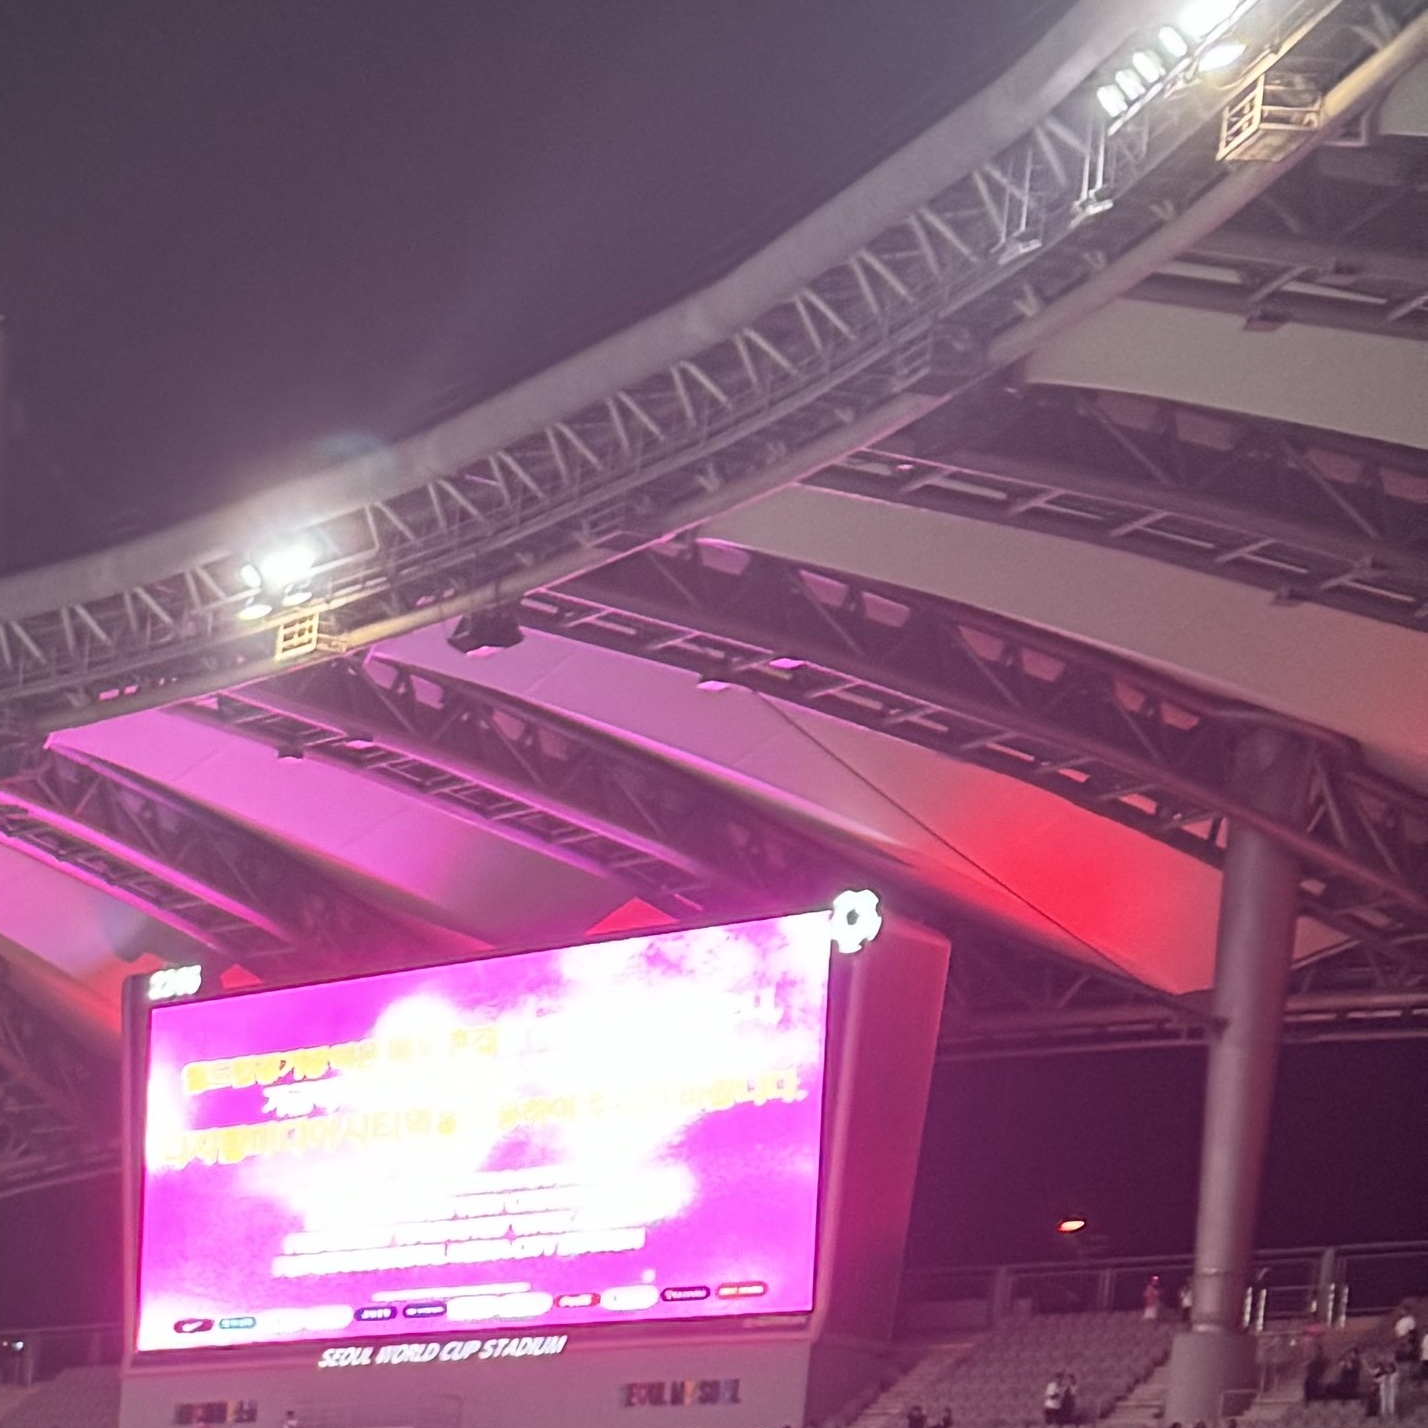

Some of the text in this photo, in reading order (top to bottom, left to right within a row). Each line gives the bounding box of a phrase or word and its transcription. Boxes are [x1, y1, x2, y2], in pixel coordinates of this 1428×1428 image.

[318, 1335, 568, 1367] SEOUL WORLD CUP STADIUM
